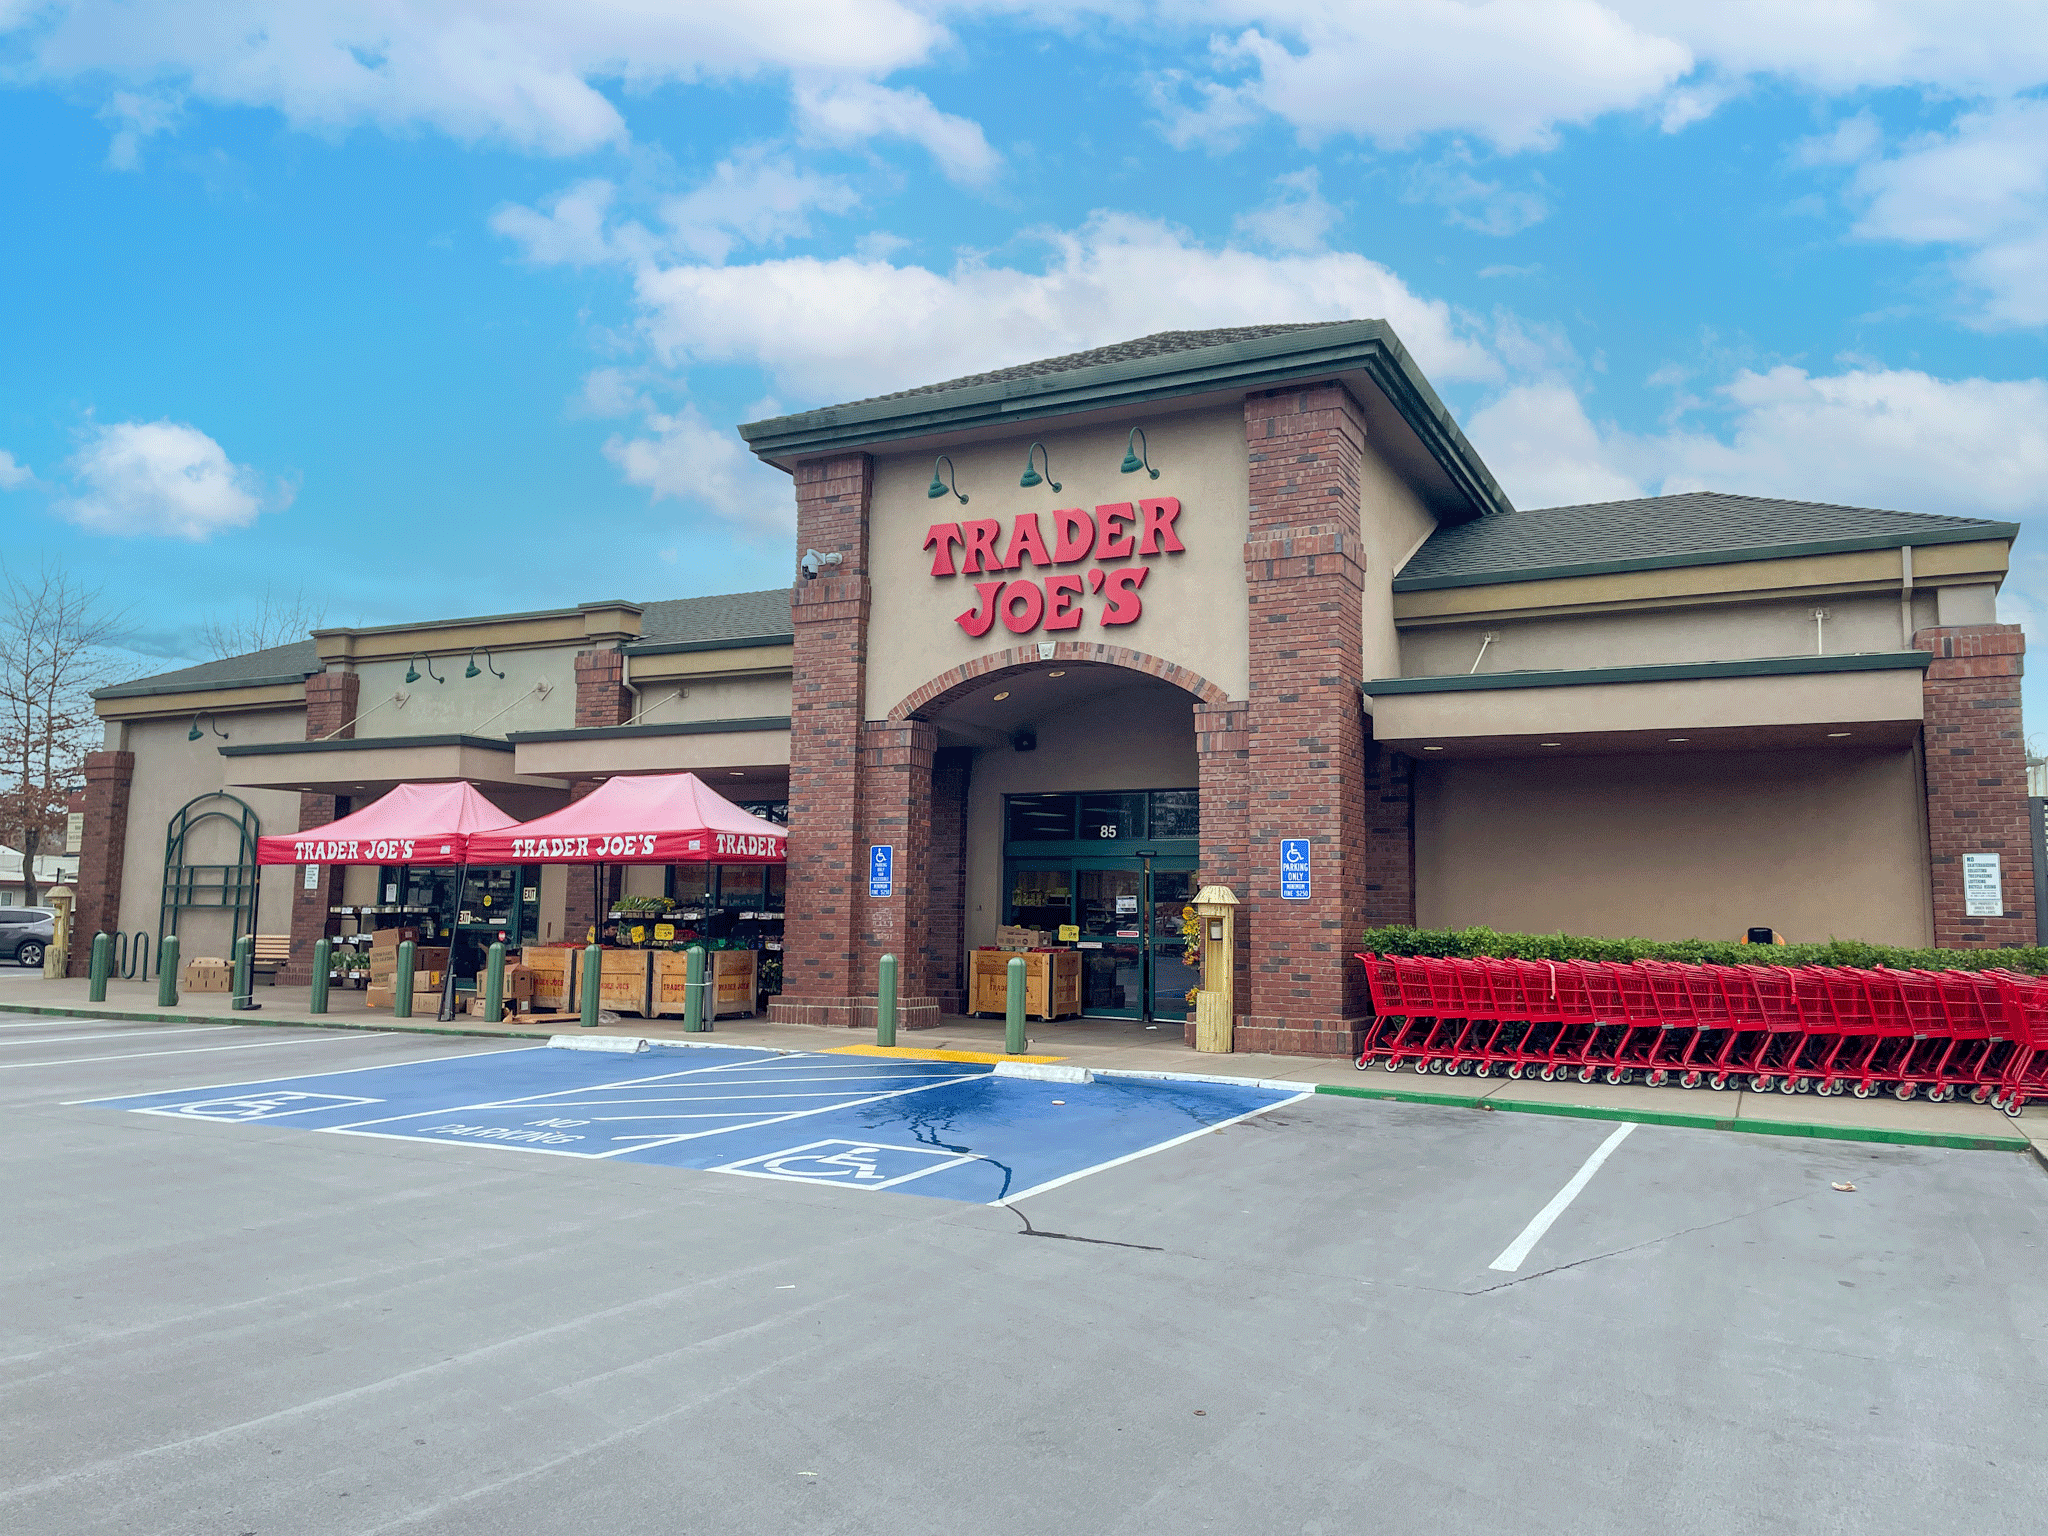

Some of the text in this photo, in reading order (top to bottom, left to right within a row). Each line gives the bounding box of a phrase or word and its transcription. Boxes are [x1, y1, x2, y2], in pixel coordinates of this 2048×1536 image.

[923, 496, 1186, 577] TRADER
[954, 567, 1150, 637] JOE'S
[1100, 825, 1117, 838] 85
[294, 839, 415, 860] TRADER JOE'S
[511, 834, 657, 858] TRADER JOE'S
[715, 833, 777, 857] TRADER
[1282, 863, 1308, 872] PARKING
[1288, 872, 1304, 880] ONLY
[524, 889, 536, 899] EXIT
[524, 1117, 591, 1129] NO
[417, 1123, 586, 1145] PARKING
